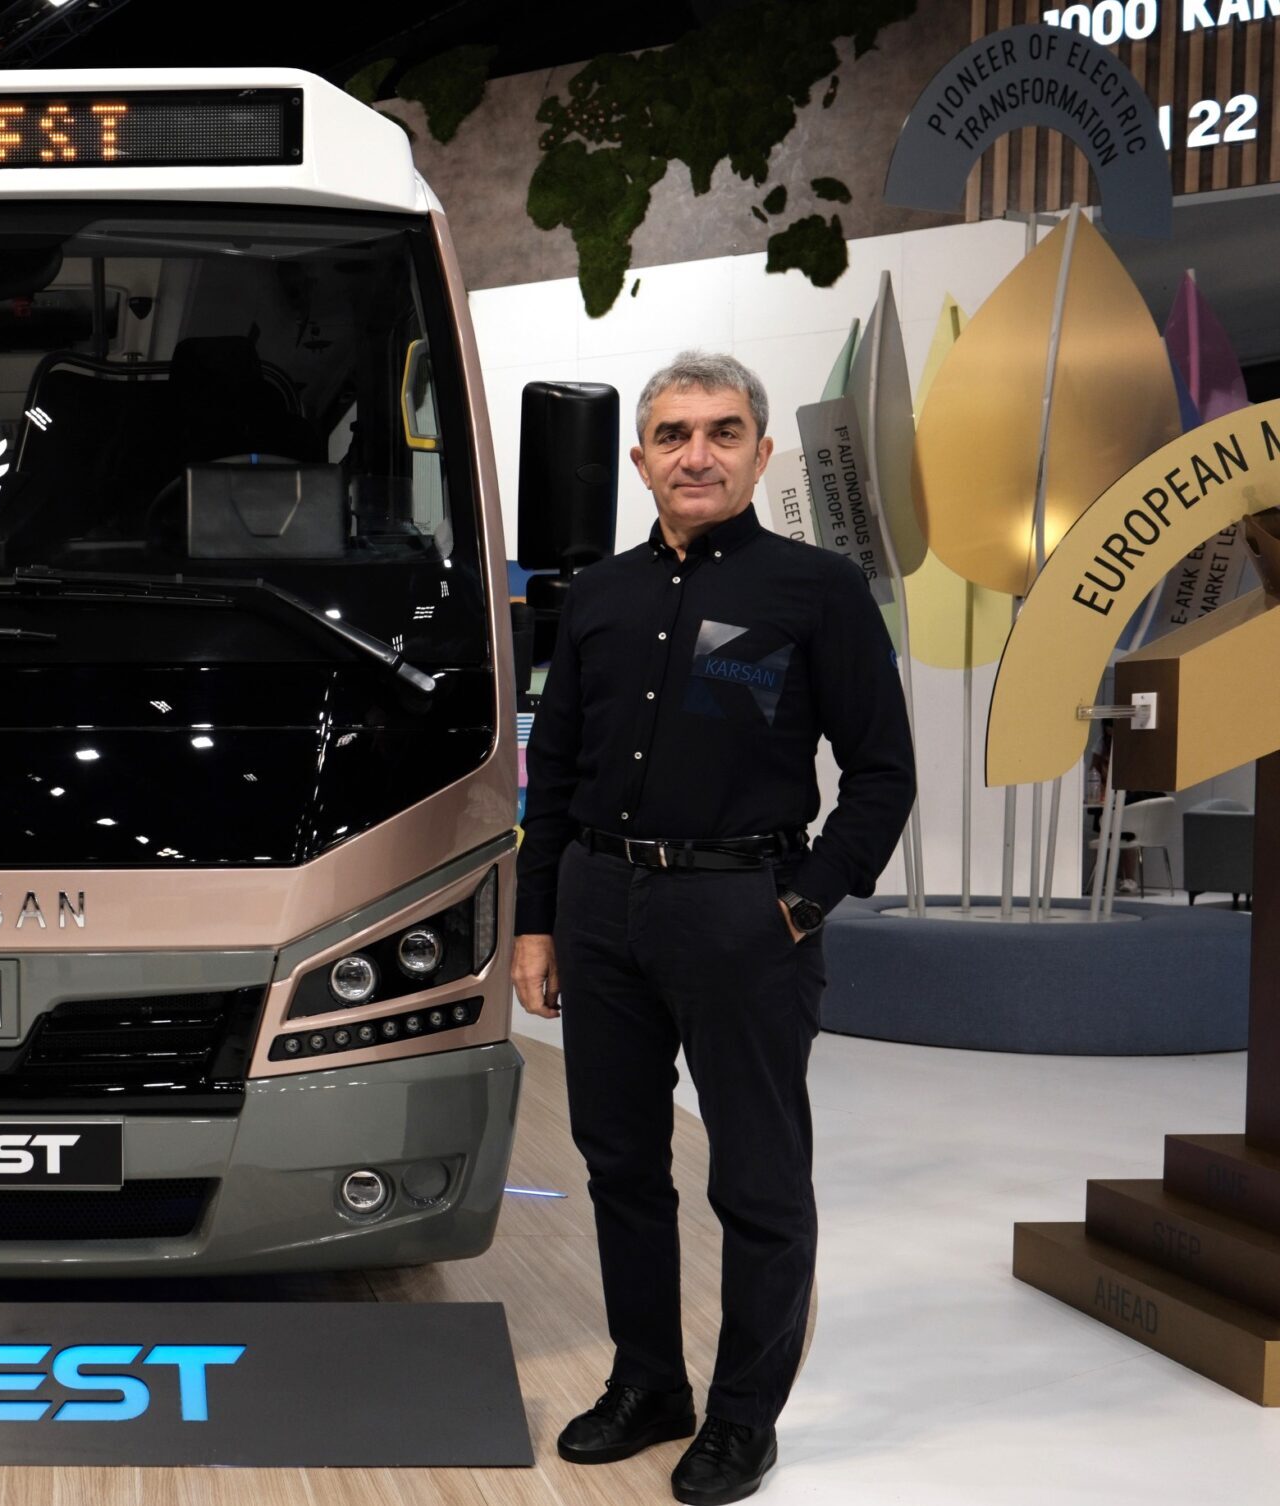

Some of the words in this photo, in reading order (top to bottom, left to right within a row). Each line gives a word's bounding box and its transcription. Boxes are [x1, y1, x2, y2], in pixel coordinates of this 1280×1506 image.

[927, 39, 1017, 136] PIONEER
[1029, 33, 1058, 61] OF
[1066, 41, 1147, 155] ELECTRIC
[954, 77, 1119, 167] TRANSFORMATION
[1187, 94, 1258, 148] 22
[817, 448, 833, 468] OF
[781, 487, 803, 525] FLEET
[822, 473, 846, 530] EUROPE
[838, 444, 870, 545] AUTONOMOUS
[859, 550, 877, 580] BUS
[1072, 433, 1249, 616] EUROPEAN
[835, 535, 849, 547] &
[1170, 568, 1200, 624] E-ATAK
[705, 659, 775, 687] KARSAN
[1152, 1221, 1201, 1262] STEP
[1094, 1275, 1158, 1334] AHEAD
